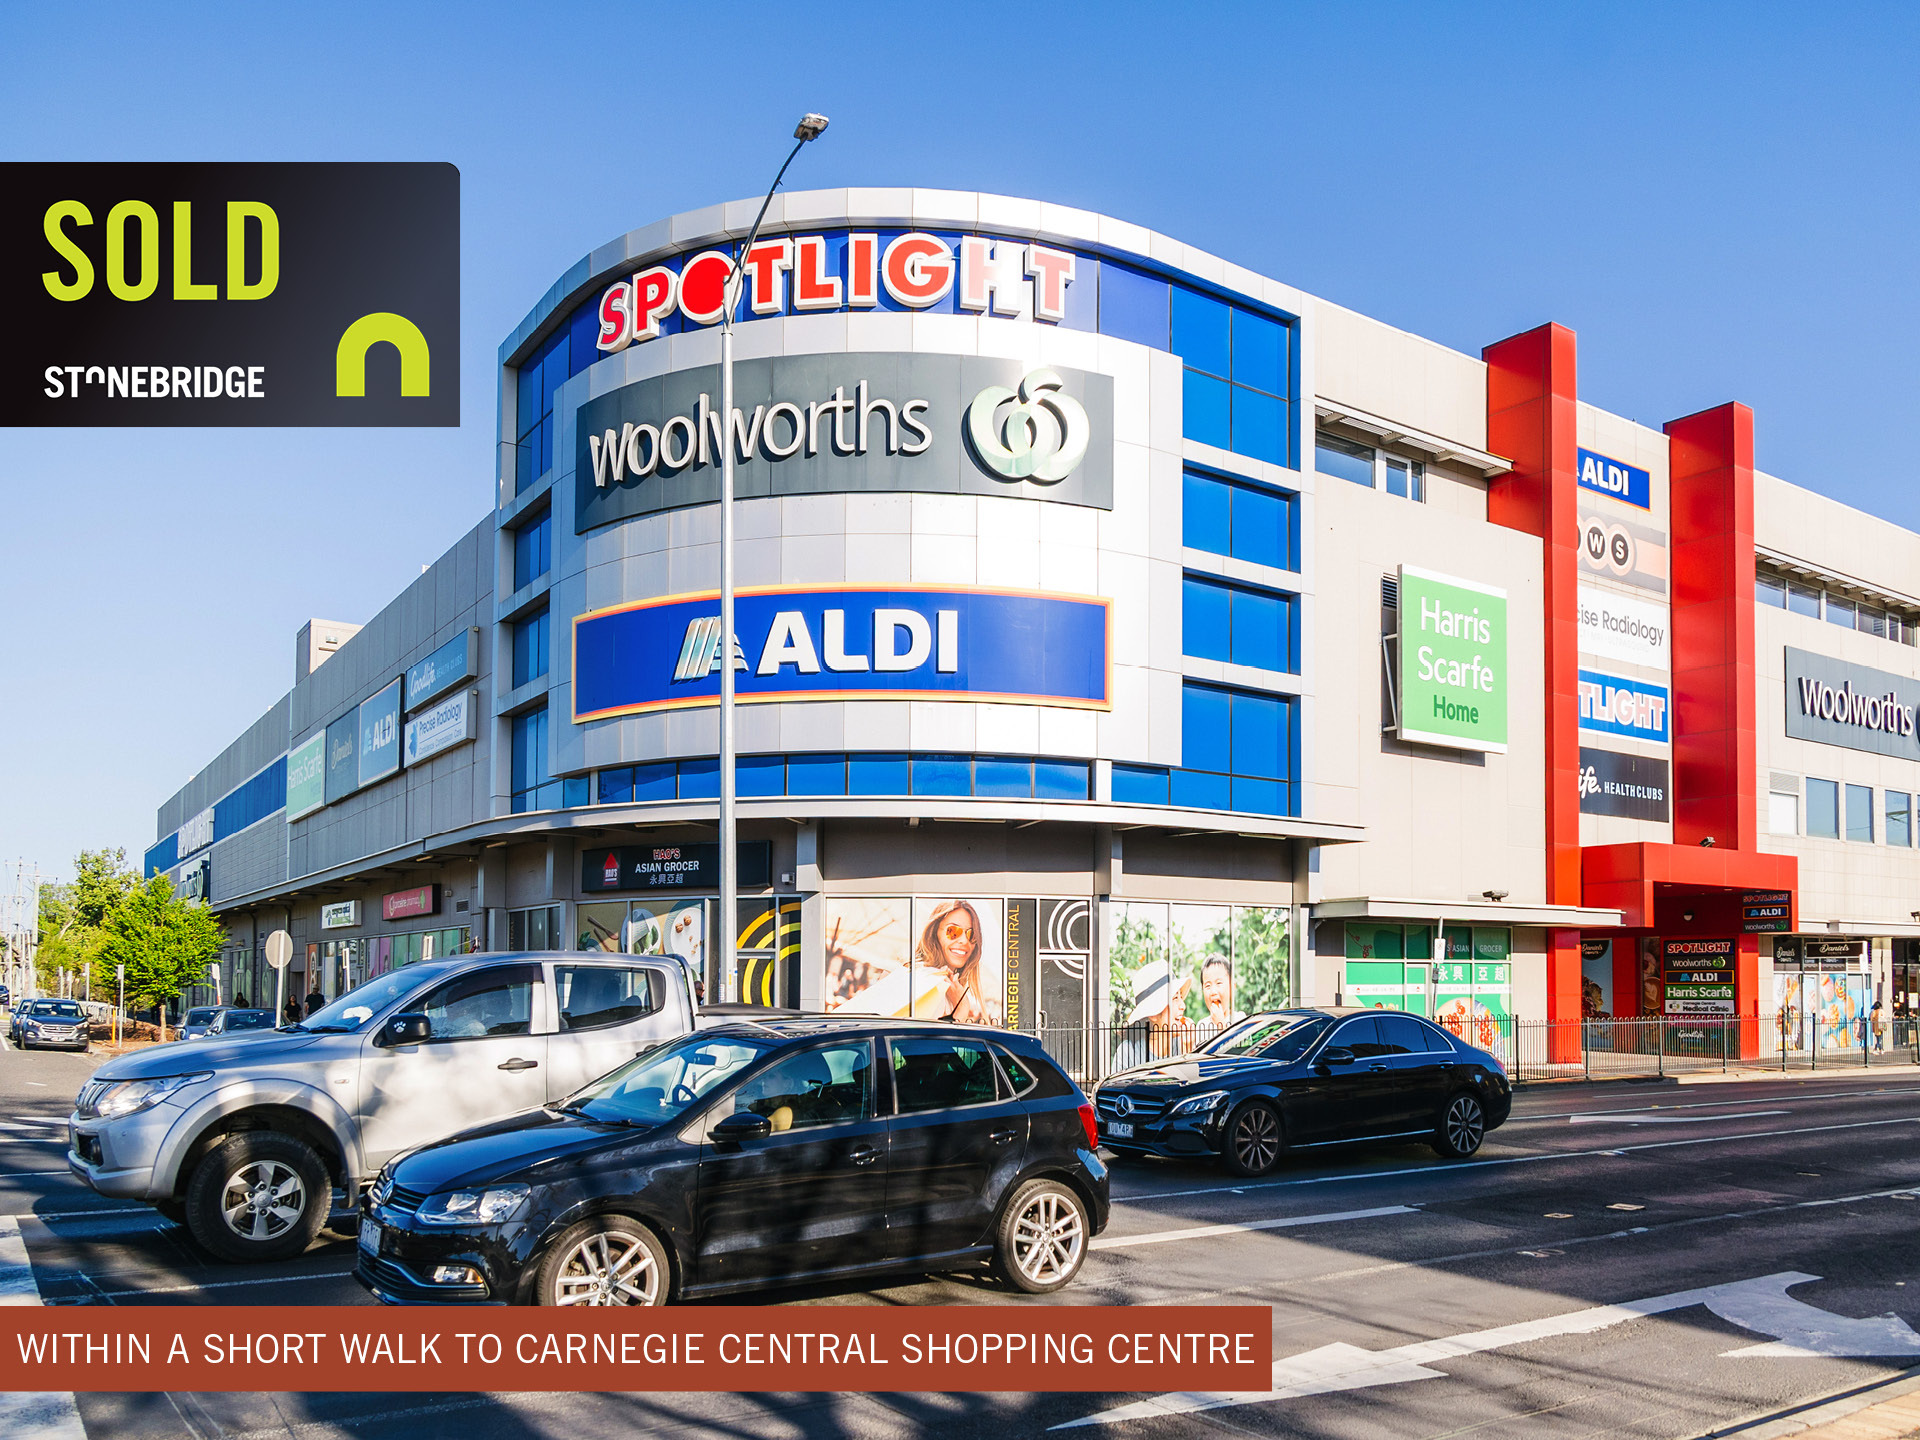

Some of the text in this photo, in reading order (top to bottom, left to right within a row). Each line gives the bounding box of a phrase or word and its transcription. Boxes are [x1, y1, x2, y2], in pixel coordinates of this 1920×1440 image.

[596, 233, 1076, 352] SPOTLIGHT
[1582, 457, 1629, 496] ALDI
[1421, 597, 1490, 644] Harris
[1602, 610, 1664, 646] Radiology
[757, 609, 958, 675] ALDI
[1418, 645, 1493, 692] Scarfe
[419, 702, 462, 736] Precise Radiology
[1433, 695, 1479, 724] Home
[1801, 677, 1914, 736] Woolworths
[372, 711, 396, 752] ALDI
[1578, 765, 1663, 801] ife. HEALTH CLUBS
[634, 860, 700, 874] ASIAN GROCER
[652, 848, 681, 860] HAO'S
[1760, 908, 1782, 916] ALDI
[1008, 904, 1020, 969] CENTRAL
[1453, 944, 1470, 953] ASIAN
[1480, 944, 1503, 953] GROCER
[1667, 942, 1730, 954] SPOTLIGHT
[1667, 986, 1732, 998] Harris Scarfe
[1691, 972, 1718, 982] ALDI
